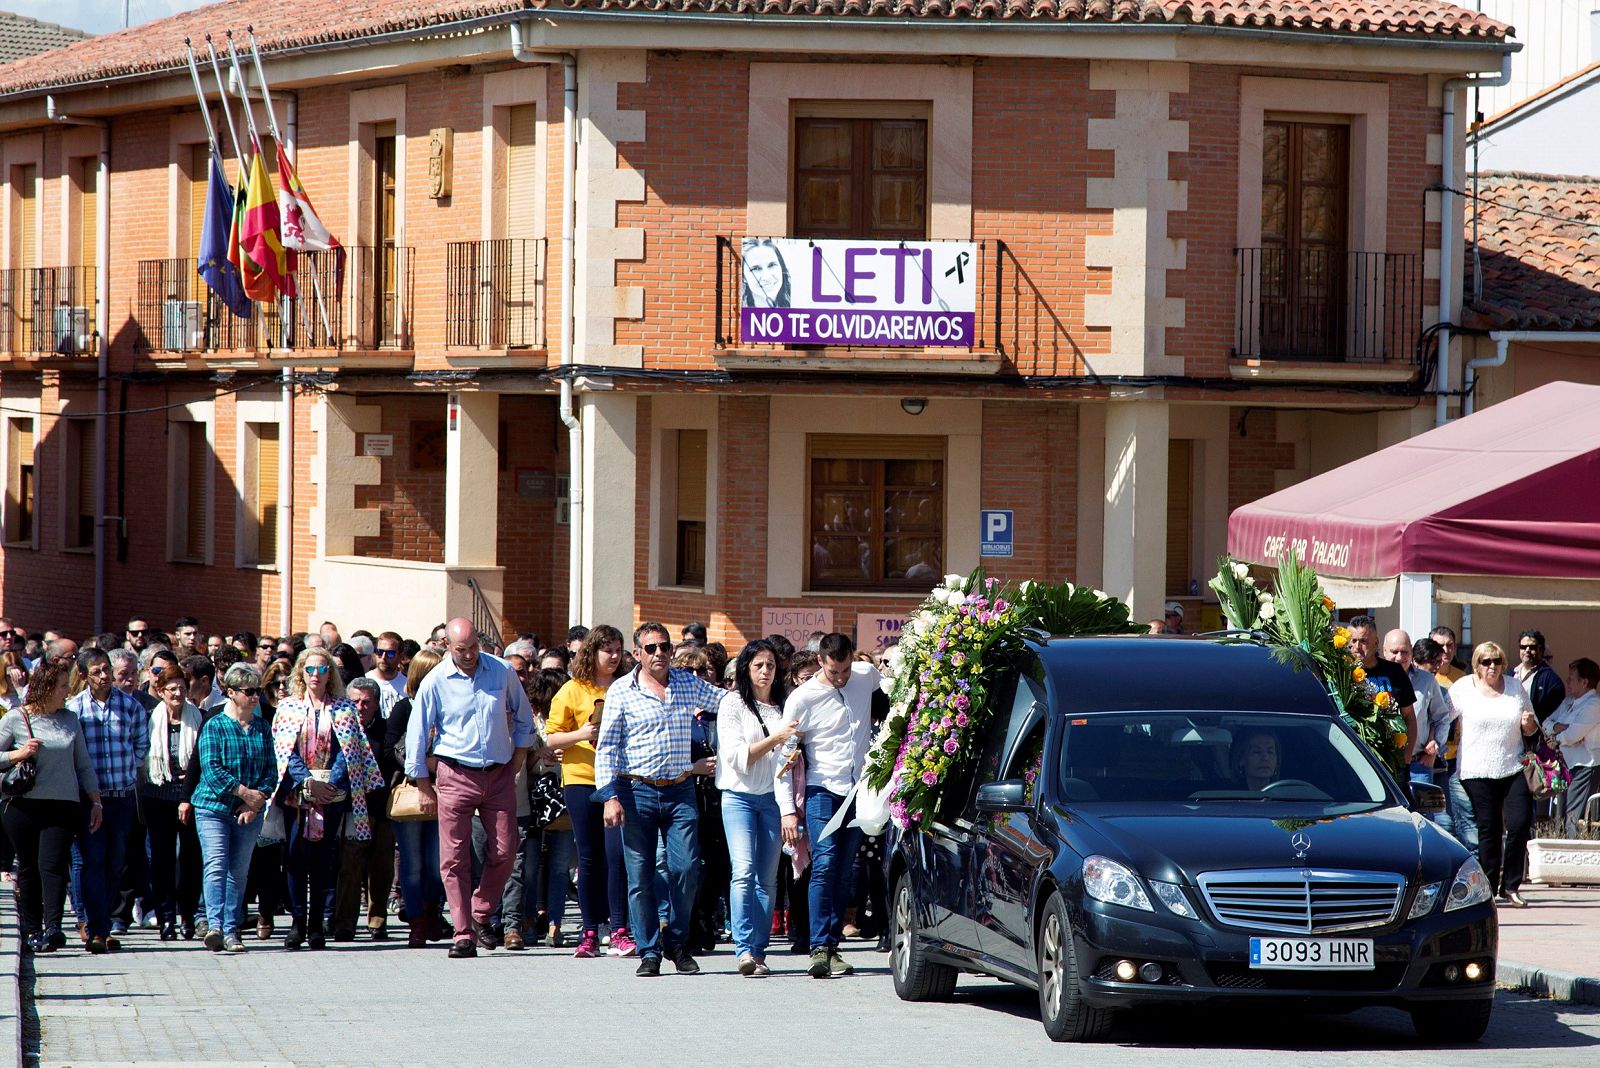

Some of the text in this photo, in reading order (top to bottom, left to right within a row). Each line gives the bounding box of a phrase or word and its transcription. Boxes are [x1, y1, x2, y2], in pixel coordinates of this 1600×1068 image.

[811, 246, 933, 305] LETI
[750, 312, 963, 341] NO TE OLVIDAREMOS
[987, 513, 1007, 541] P
[1263, 531, 1286, 558] CAFÉ
[766, 611, 826, 627] JUSTICIA
[784, 629, 811, 642] POR
[1266, 941, 1369, 963] 3093 HNR
